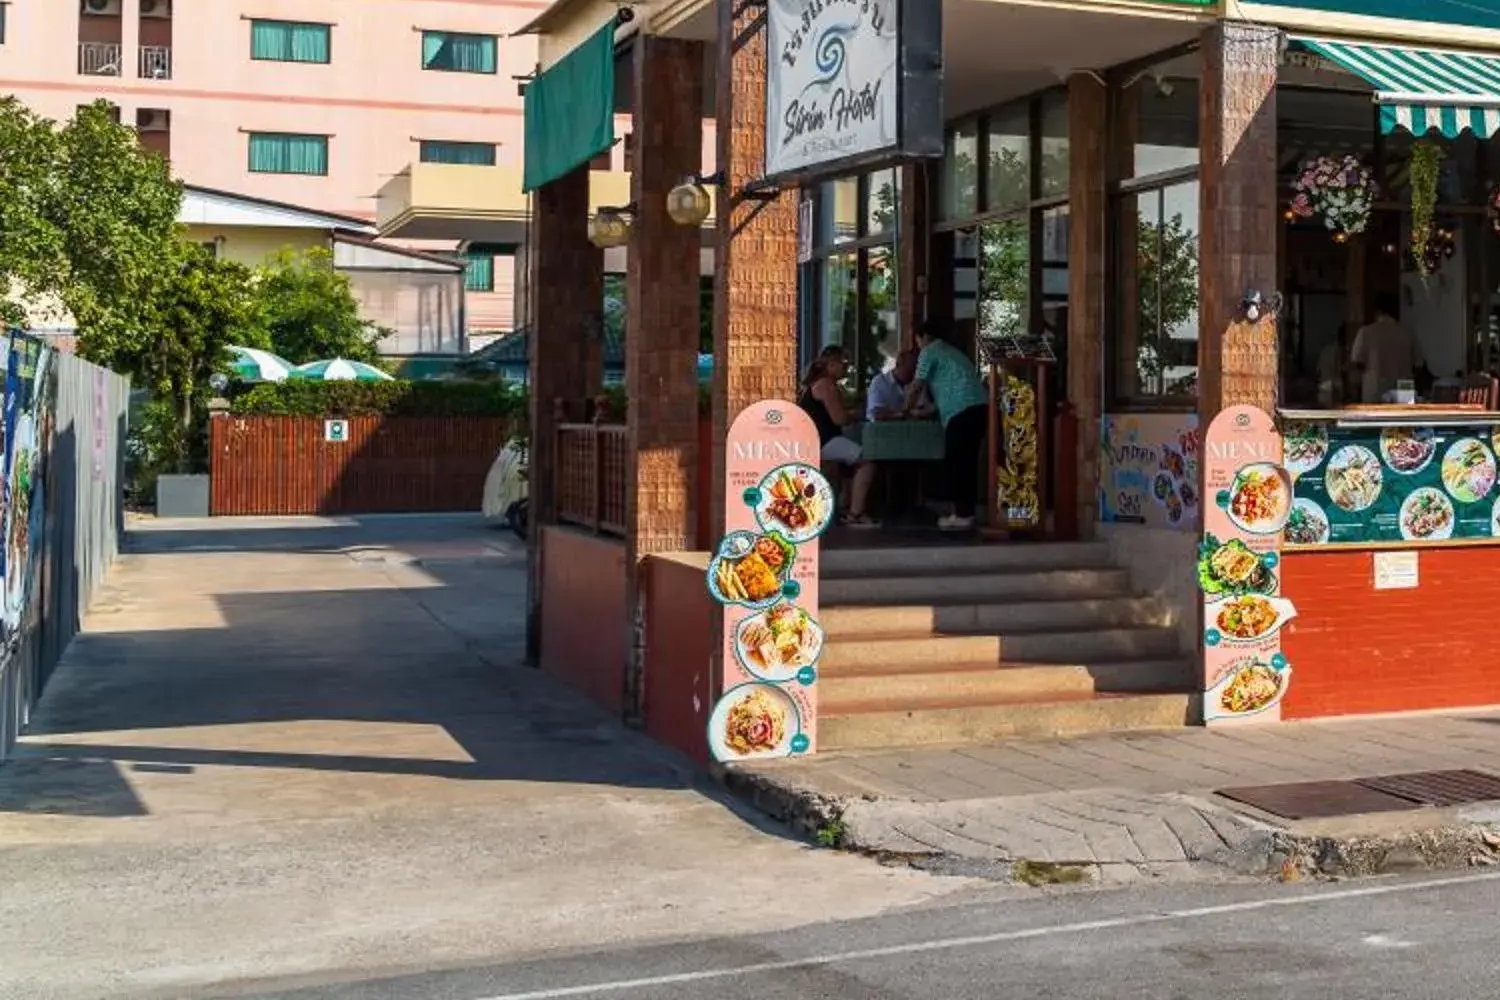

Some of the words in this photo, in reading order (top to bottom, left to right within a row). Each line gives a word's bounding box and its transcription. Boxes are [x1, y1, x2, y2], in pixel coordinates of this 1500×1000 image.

[783, 98, 826, 146] Sirin
[829, 78, 882, 132] Hotel
[732, 440, 813, 461] MENU
[1208, 440, 1276, 461] MENU
